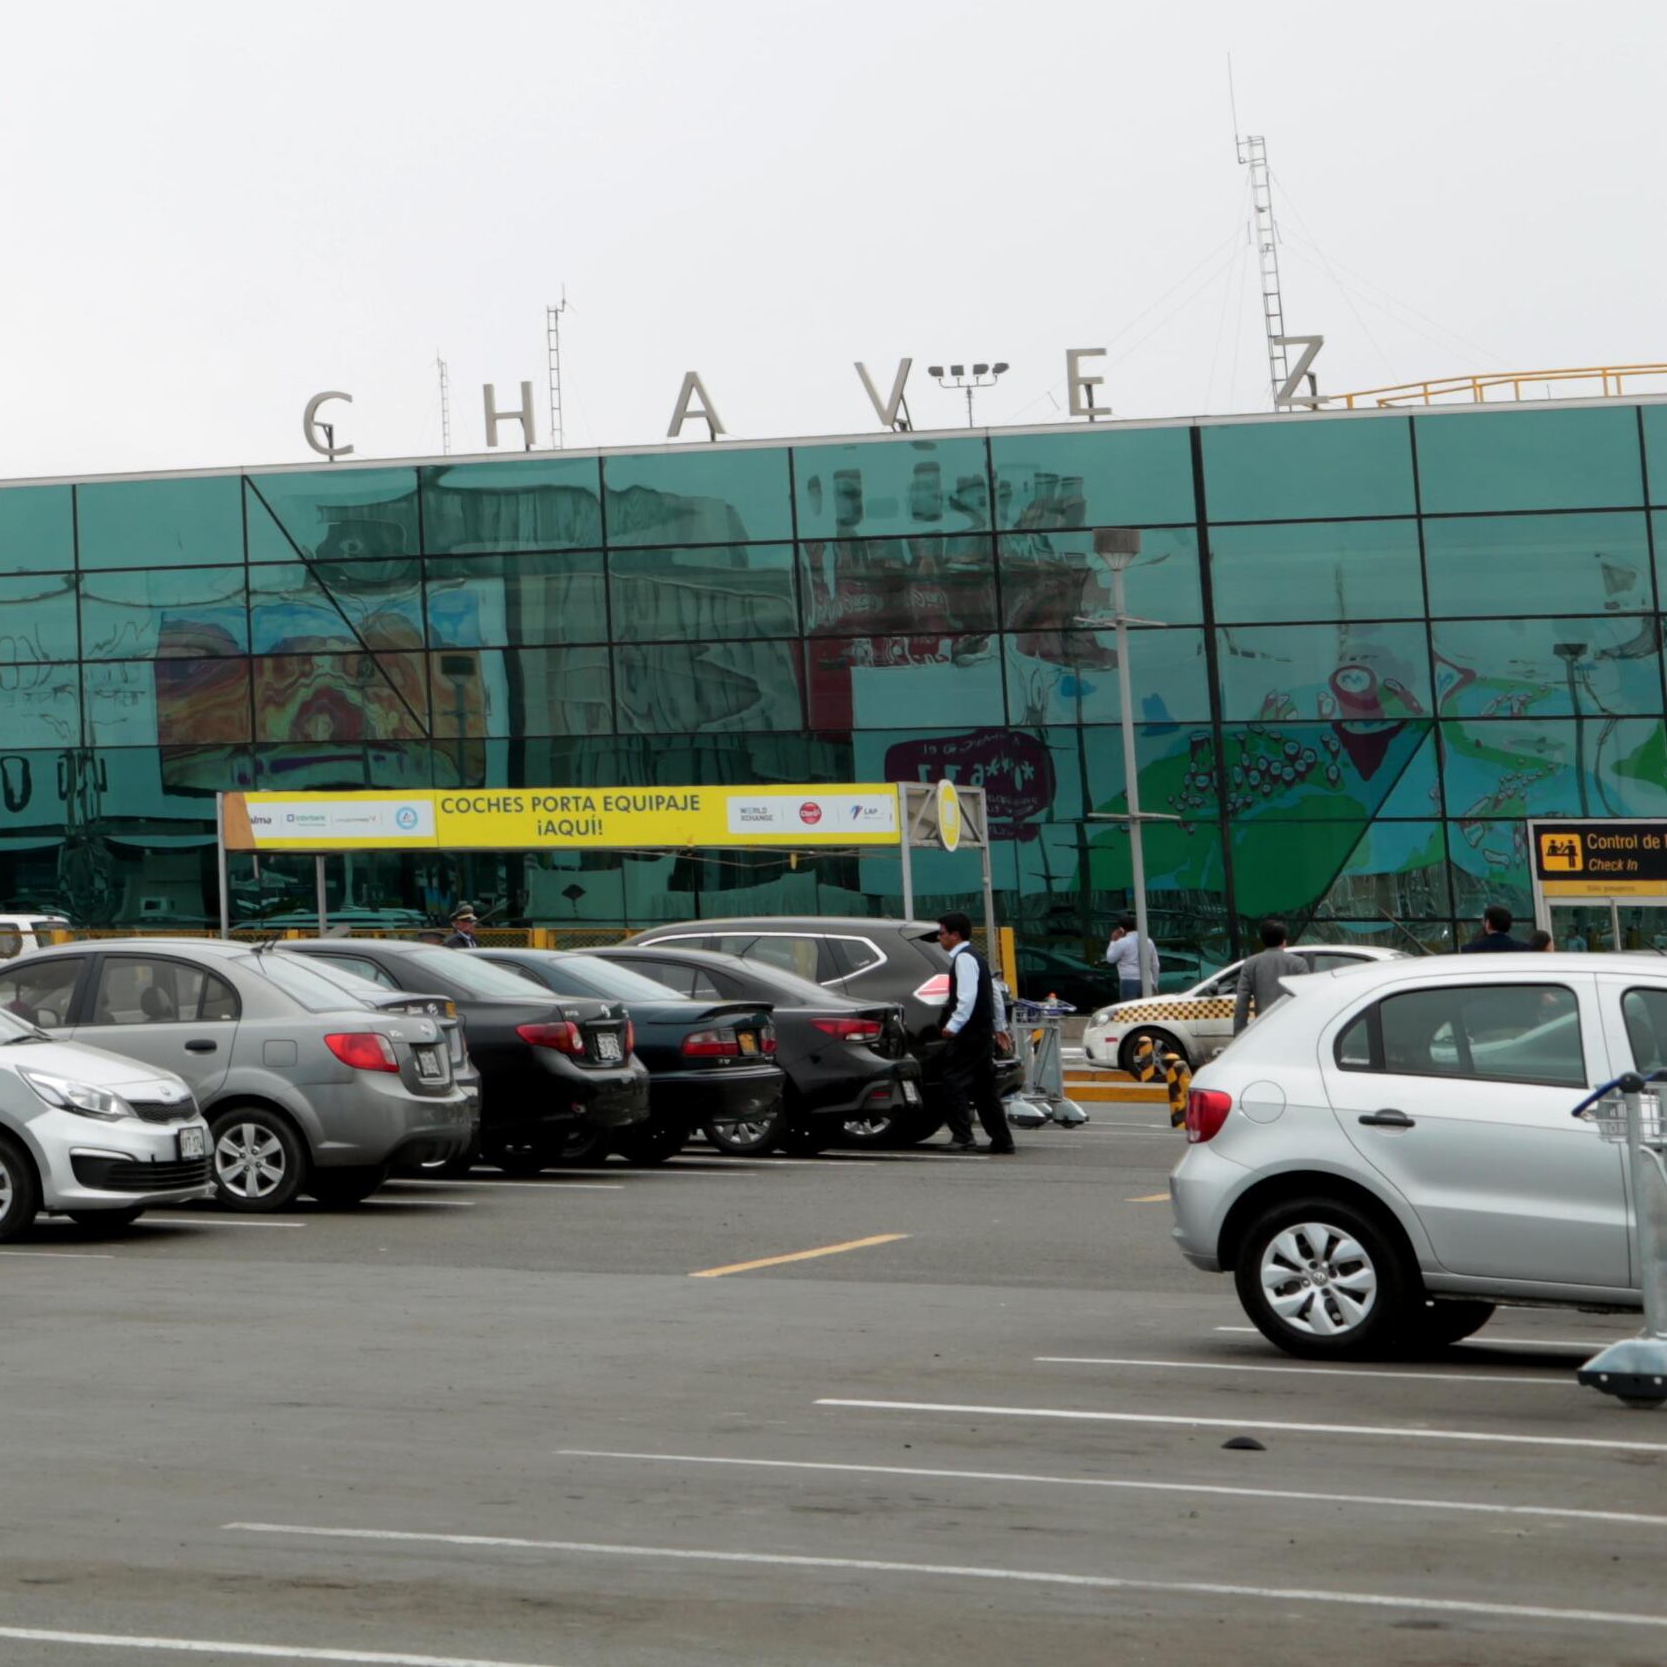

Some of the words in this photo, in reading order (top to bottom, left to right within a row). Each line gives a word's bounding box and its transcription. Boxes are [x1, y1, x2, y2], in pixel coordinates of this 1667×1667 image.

[303, 334, 1330, 456] CHAVEZ
[441, 797, 524, 813] COCHES
[531, 795, 596, 813] PORTA
[603, 794, 700, 813] EQUIPAJE
[537, 814, 603, 836] ¡AQUÍ!
[1587, 833, 1638, 850] Control
[1642, 834, 1661, 850] de
[1588, 858, 1625, 871] Check
[1627, 859, 1638, 871] In
